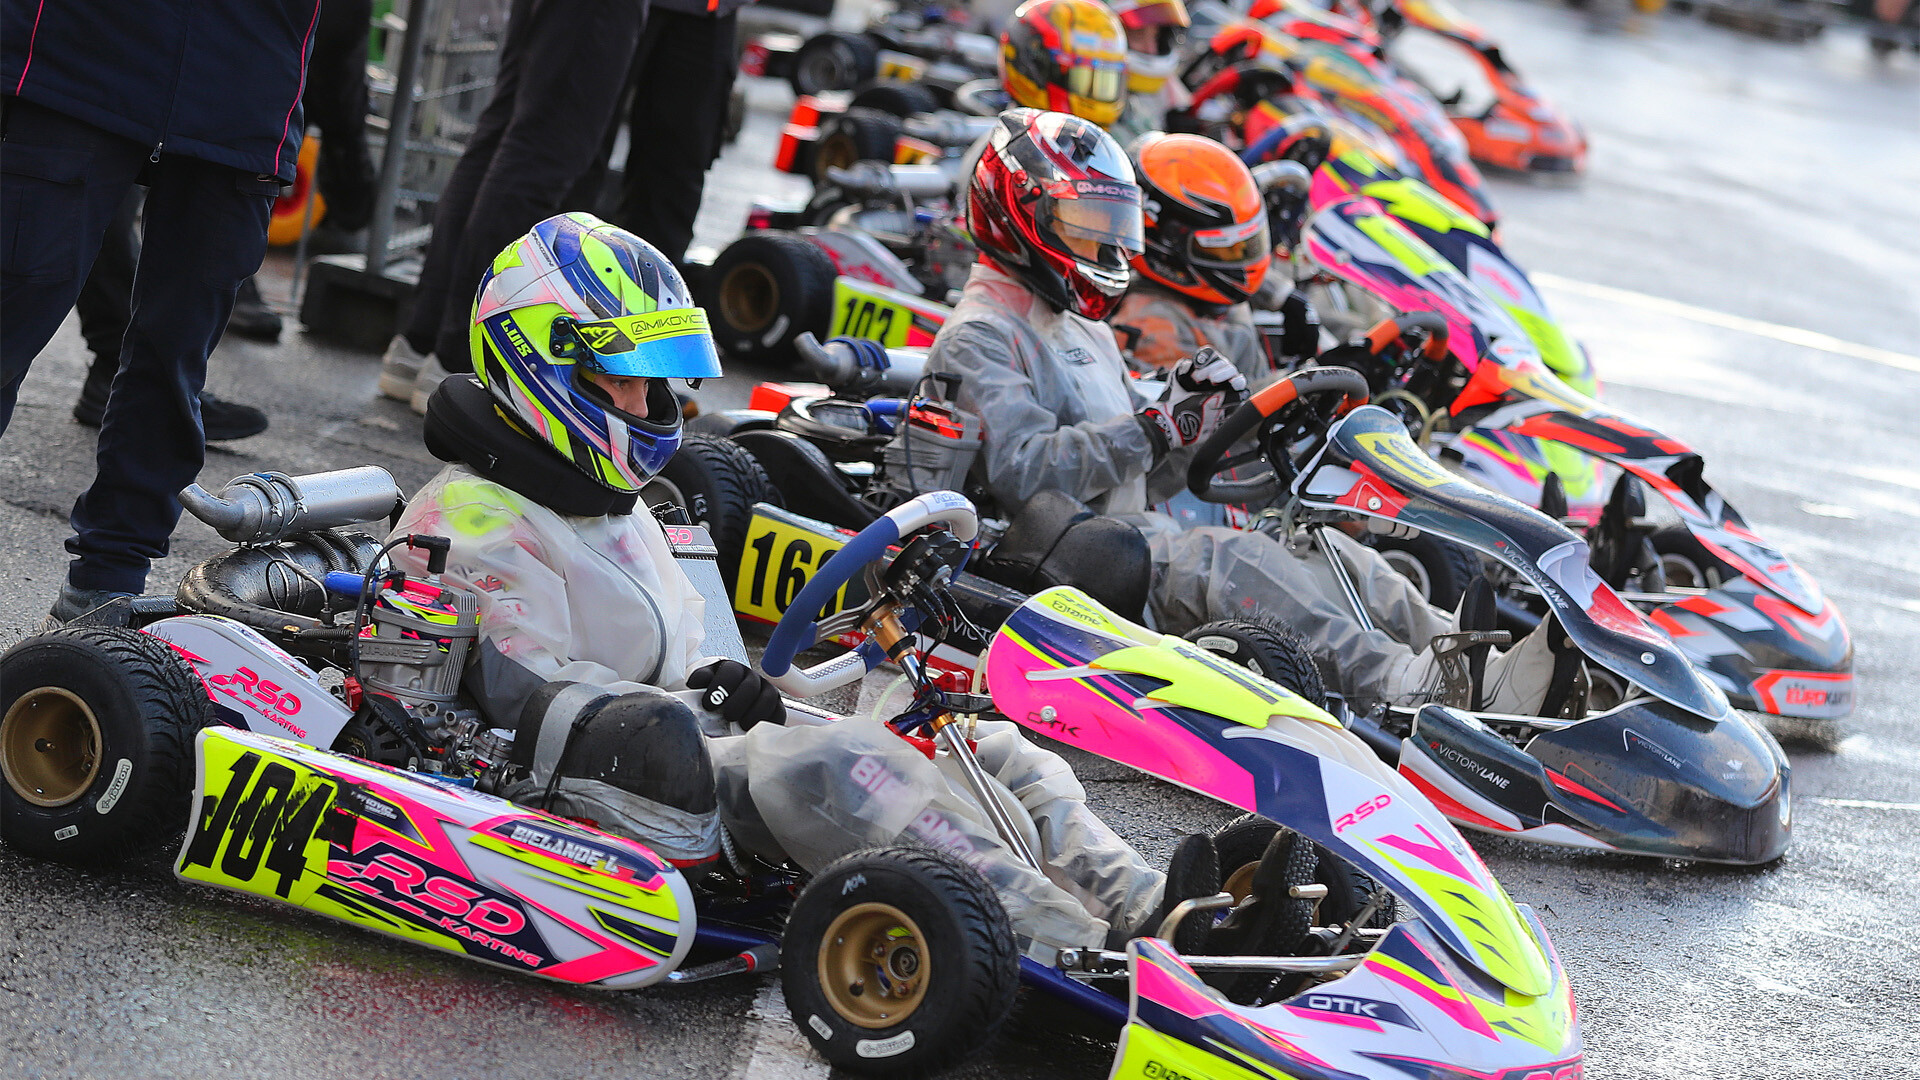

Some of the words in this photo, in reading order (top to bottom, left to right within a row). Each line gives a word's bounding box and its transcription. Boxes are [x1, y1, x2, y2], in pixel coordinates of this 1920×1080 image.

[499, 318, 535, 358] LUIS
[1494, 541, 1569, 610] #VICTORYLANE
[229, 666, 302, 716] RSD
[262, 708, 307, 739] KARTING
[1430, 741, 1511, 790] #VICTORYLANE
[182, 751, 335, 900] 104
[1335, 794, 1392, 833] RSD
[510, 824, 605, 868] BIELANDE
[360, 853, 526, 936] RSD
[440, 917, 542, 968] KARTING
[1308, 995, 1379, 1015] OTK
